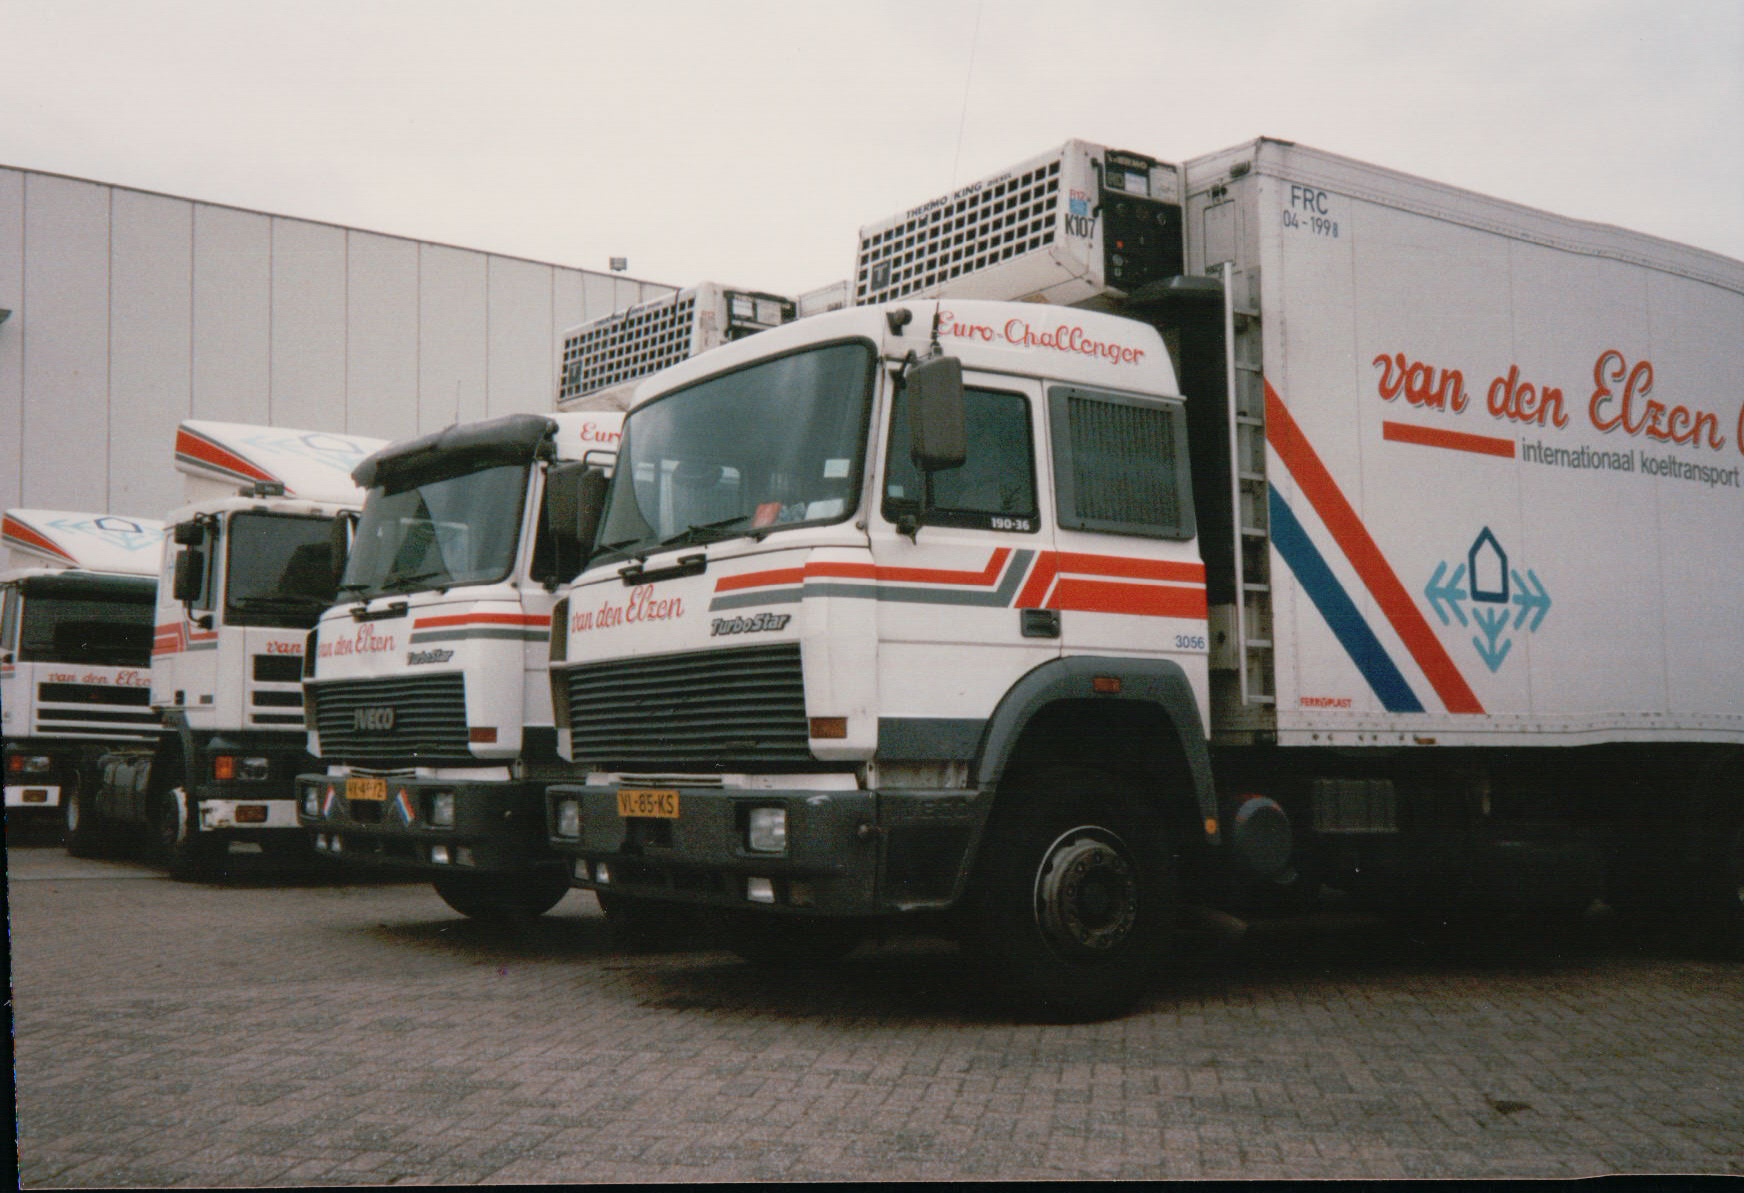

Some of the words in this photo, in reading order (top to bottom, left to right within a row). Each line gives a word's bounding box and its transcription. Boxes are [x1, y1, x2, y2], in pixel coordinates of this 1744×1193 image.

[905, 195, 949, 219] THERMO
[953, 180, 983, 200] KING
[1291, 185, 1329, 215] FRC
[1065, 212, 1096, 240] K107
[1372, 352, 1468, 412] van
[1486, 364, 1570, 429] den
[1588, 349, 1727, 452] Elzen
[1521, 436, 1635, 473] internationaal
[1640, 456, 1741, 489] koeltransport
[571, 611, 593, 633] van
[596, 601, 623, 628] den
[625, 584, 684, 624] Elzen
[354, 624, 396, 655] Elzen
[710, 613, 792, 637] TurboStar
[265, 640, 302, 654] van
[1175, 635, 1206, 650] 3056
[355, 707, 395, 731] IVECO
[618, 793, 675, 814] VL-85-KS
